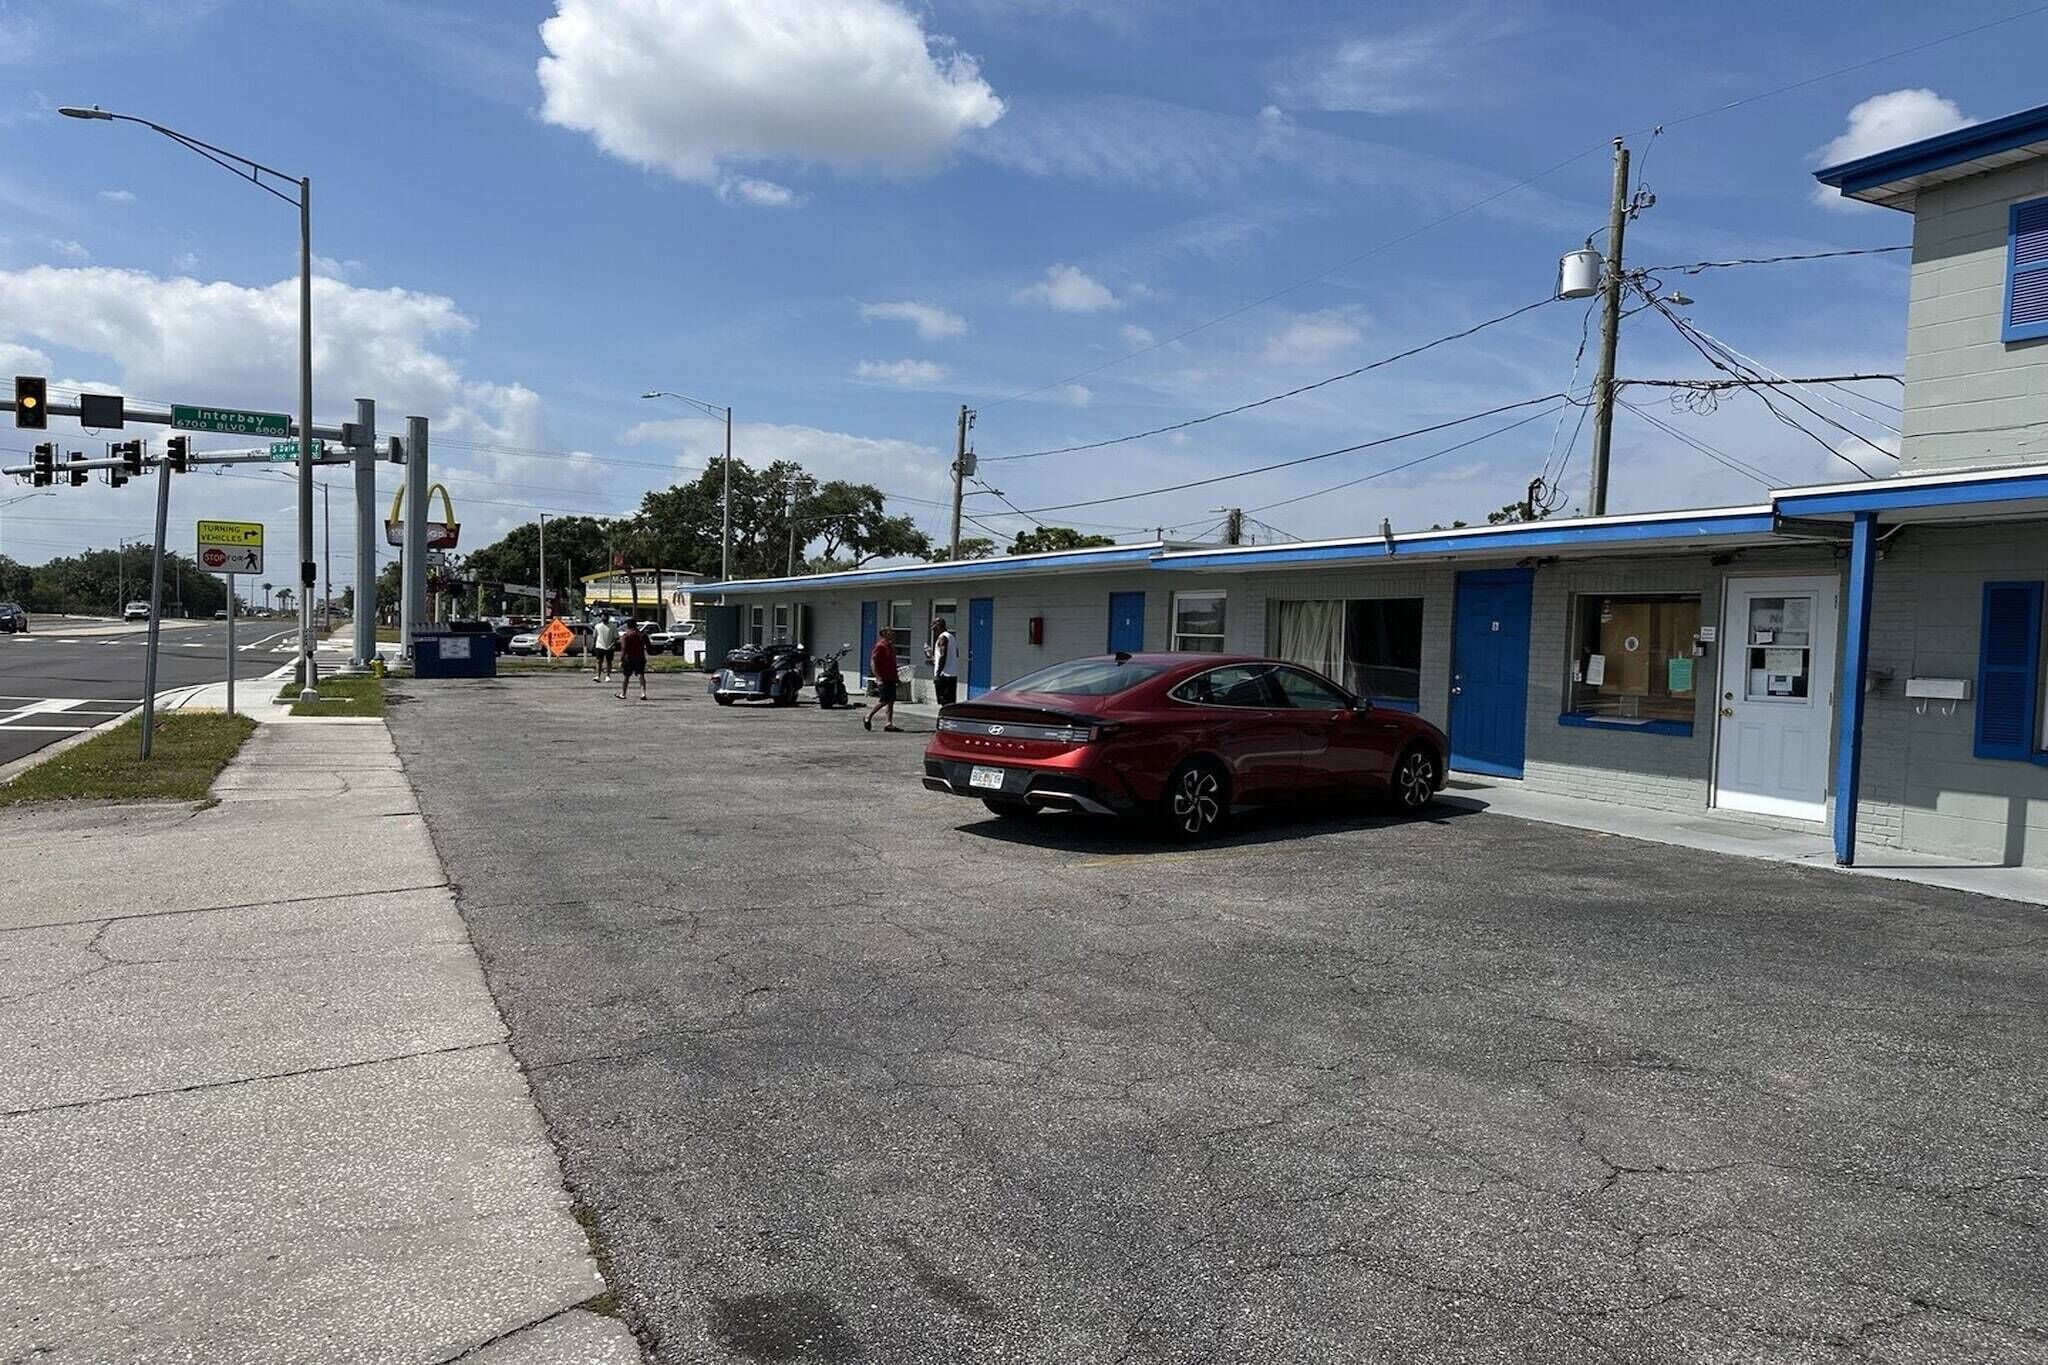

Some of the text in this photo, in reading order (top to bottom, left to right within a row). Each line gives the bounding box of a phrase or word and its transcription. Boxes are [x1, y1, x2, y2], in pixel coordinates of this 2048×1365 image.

[198, 409, 265, 425] Interbay
[176, 419, 208, 428] 6700
[217, 422, 246, 432] BLVD
[203, 525, 241, 533] TURNING
[201, 534, 243, 542] VEHICLES
[204, 553, 224, 561] STOP
[964, 739, 1025, 751] SONATA
